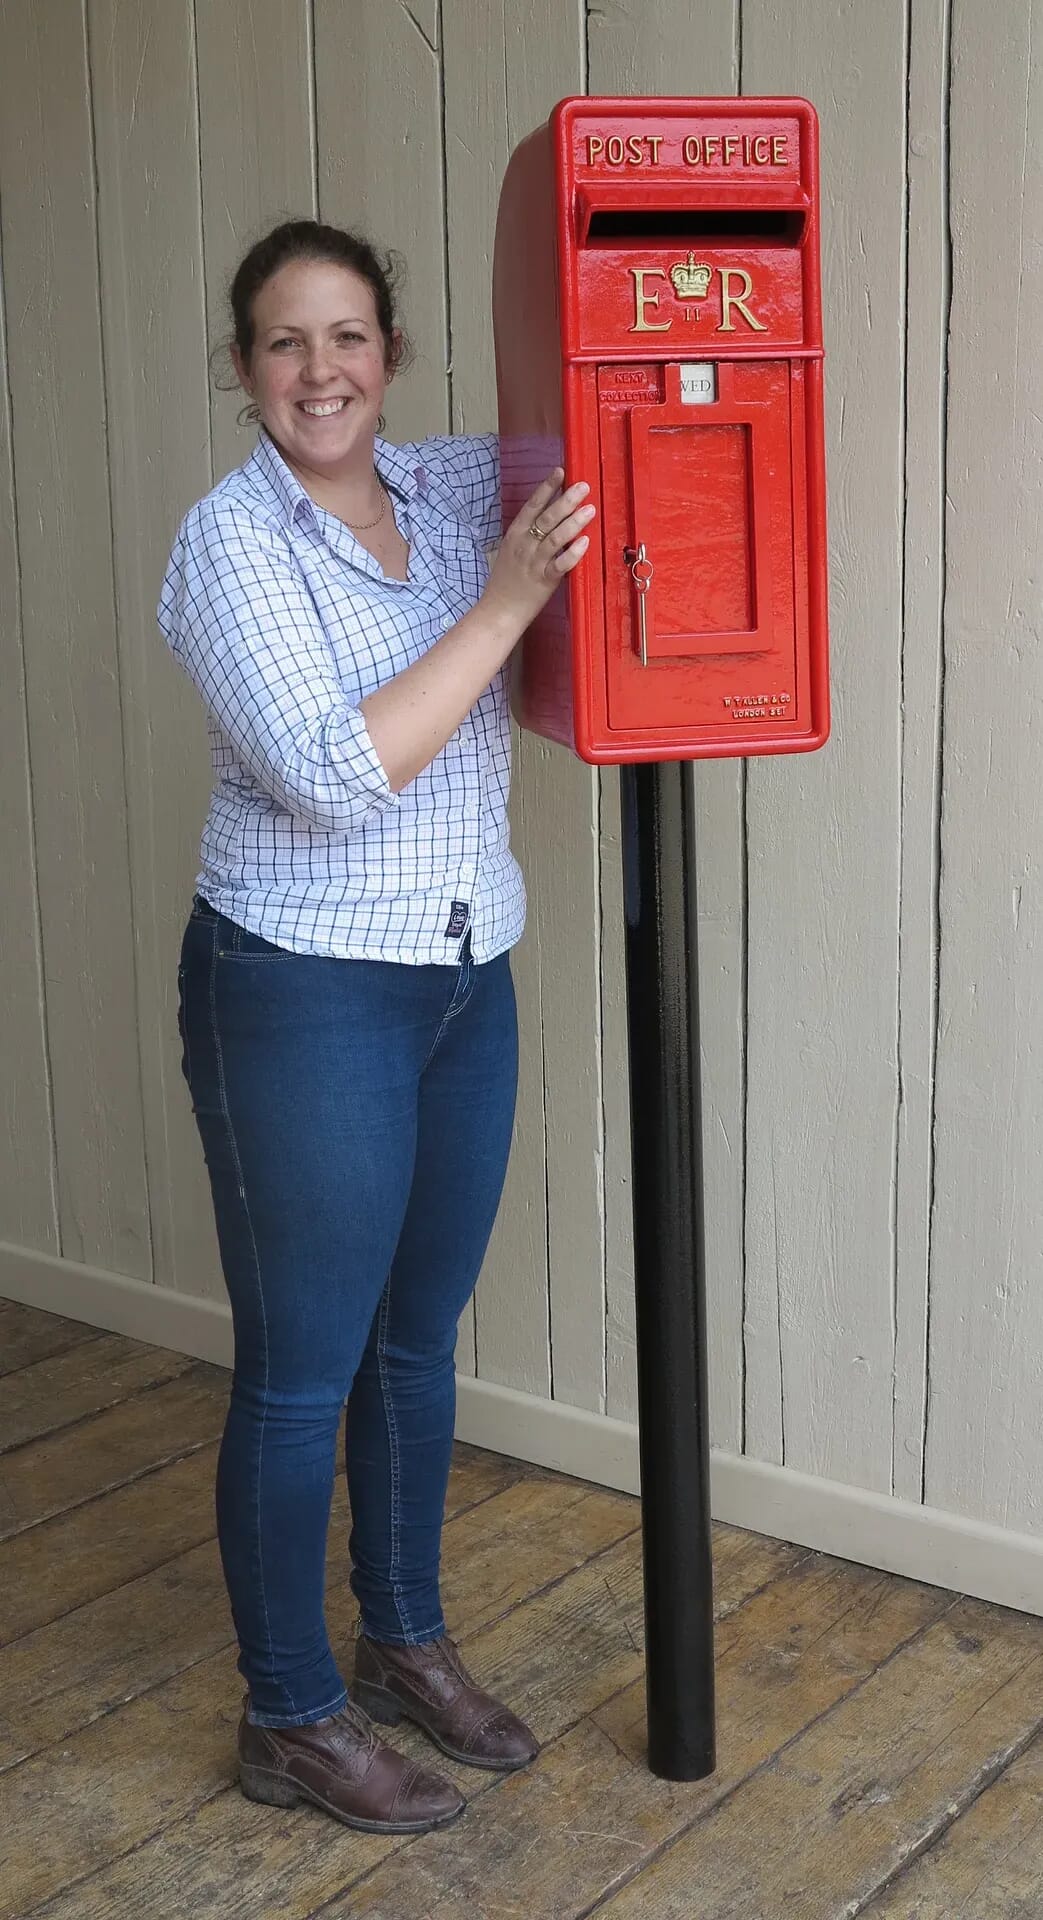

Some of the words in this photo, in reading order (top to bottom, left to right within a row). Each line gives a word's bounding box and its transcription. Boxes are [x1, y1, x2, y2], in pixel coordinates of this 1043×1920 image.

[588, 136, 663, 166] POST
[684, 136, 788, 166] OFFICE
[630, 268, 673, 332] E
[716, 267, 768, 331] R
[615, 373, 645, 384] NEXT
[599, 391, 661, 402] COLLECTIO
[742, 696, 769, 706] ALLEN
[732, 709, 766, 719] LONDON
